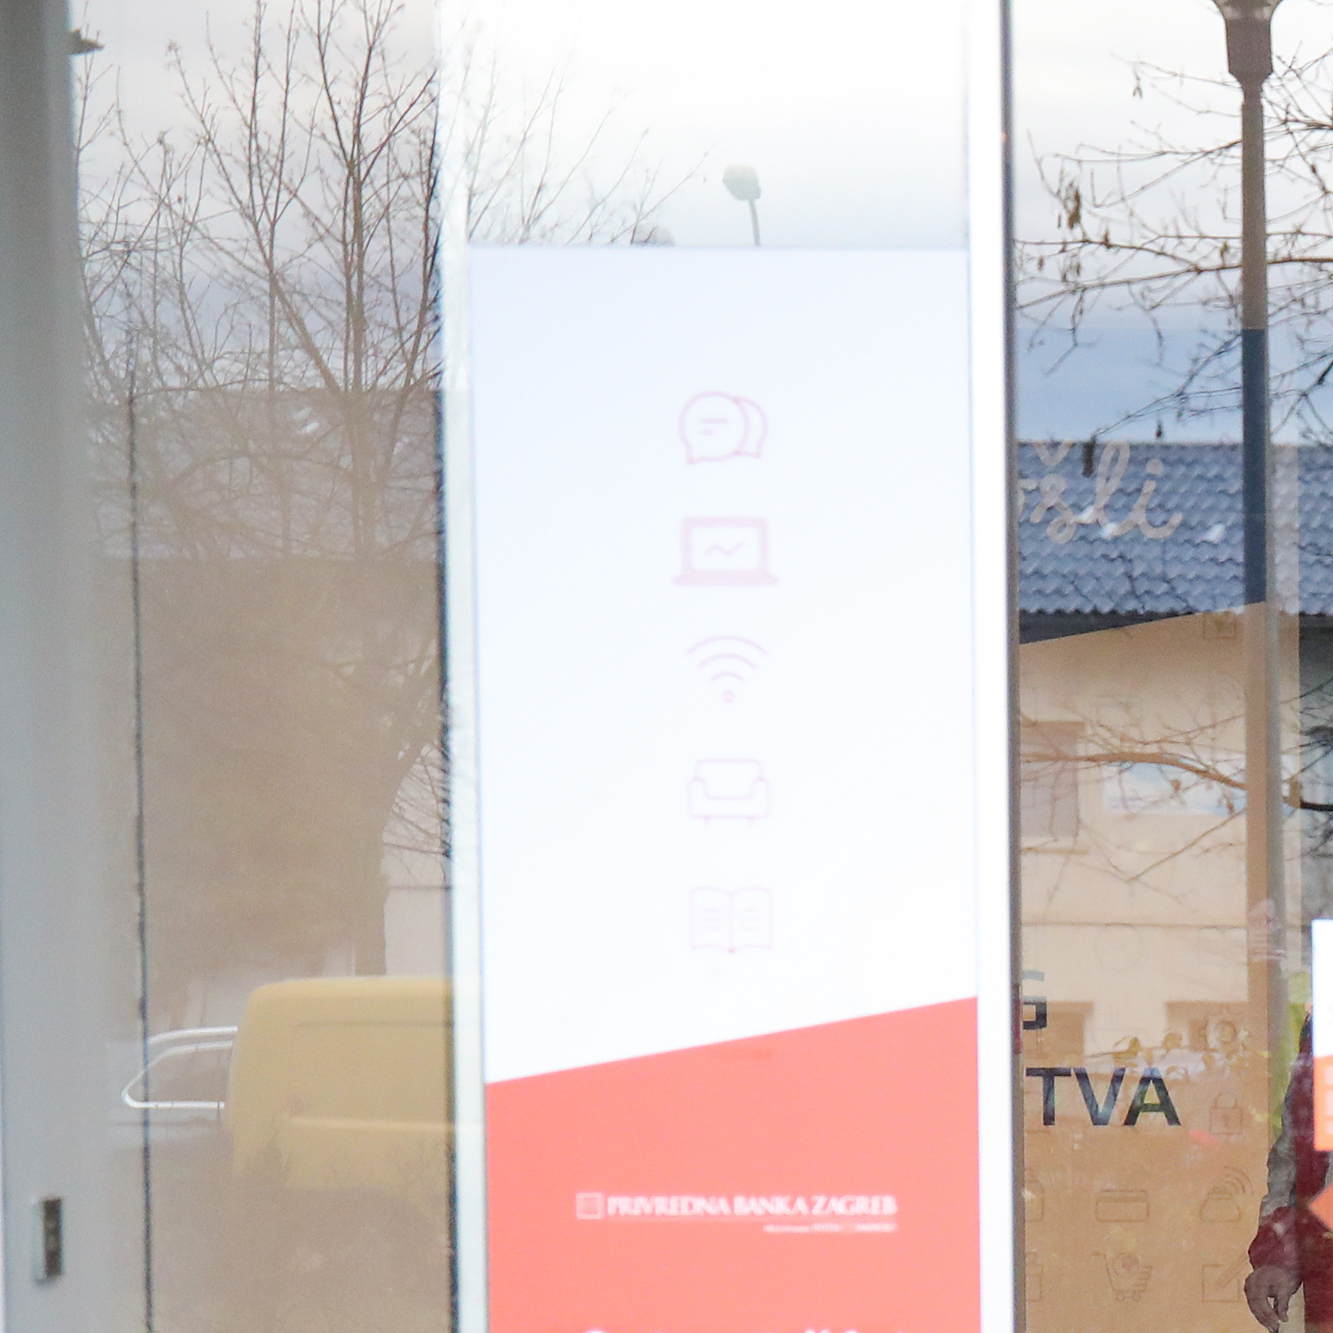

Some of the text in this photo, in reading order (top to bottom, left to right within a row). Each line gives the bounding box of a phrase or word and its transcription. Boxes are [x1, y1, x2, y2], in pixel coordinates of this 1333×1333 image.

[607, 1194, 898, 1216] PRIVREDNA BANKA ZAGREB
